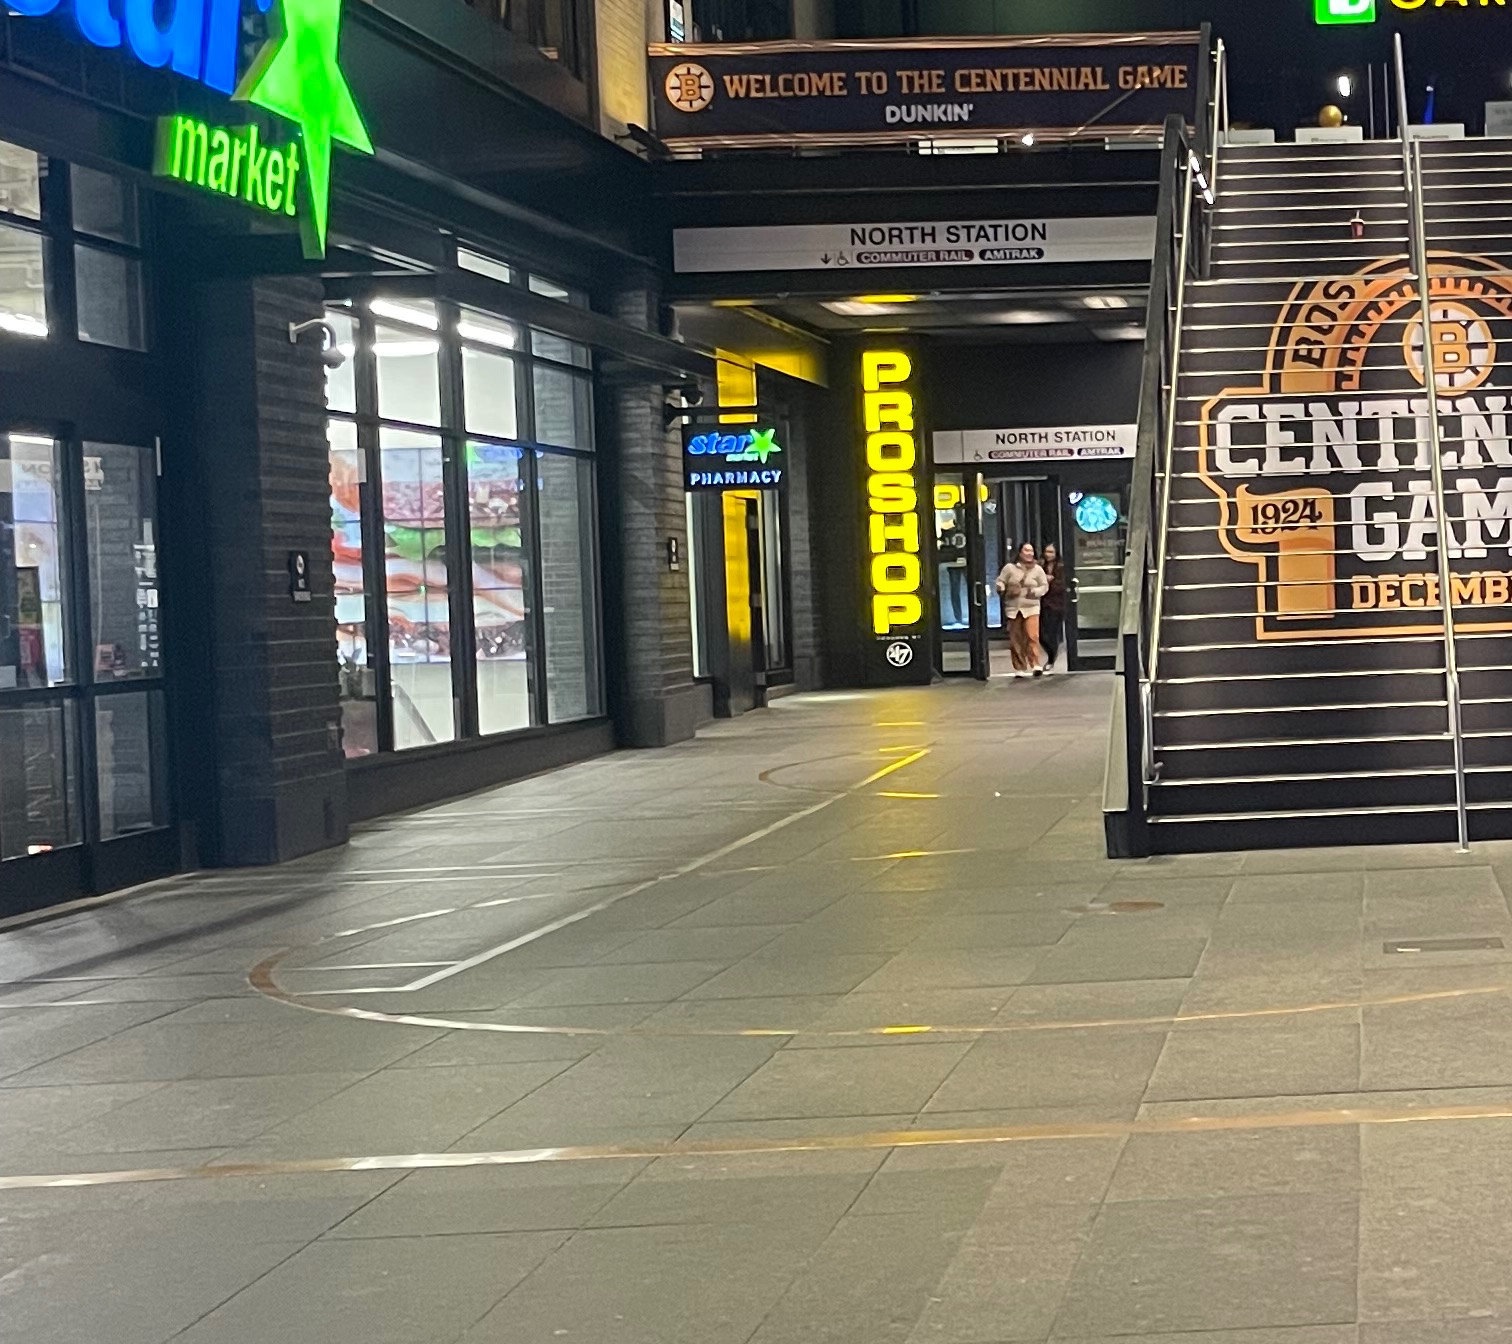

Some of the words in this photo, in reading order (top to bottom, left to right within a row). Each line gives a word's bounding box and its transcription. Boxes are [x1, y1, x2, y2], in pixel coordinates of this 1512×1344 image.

[723, 71, 847, 99] WELCOME
[855, 70, 888, 96] TO
[896, 69, 945, 94] THE
[954, 66, 1109, 93] CENTENNIAL
[1118, 64, 1188, 90] GAME
[884, 102, 974, 125] DUNKIN'
[174, 115, 301, 217] market
[850, 225, 937, 246] NORTH
[946, 222, 1047, 244] STATION
[860, 251, 937, 264] COMMUTER
[939, 249, 970, 262] RAIL
[982, 247, 1041, 261] AMTRAK
[995, 432, 1049, 445] NORTH
[1054, 430, 1116, 443] STATION
[690, 470, 782, 486] PHARMACY
[861, 351, 922, 635] PROSHOP
[1249, 502, 1323, 537] 1924
